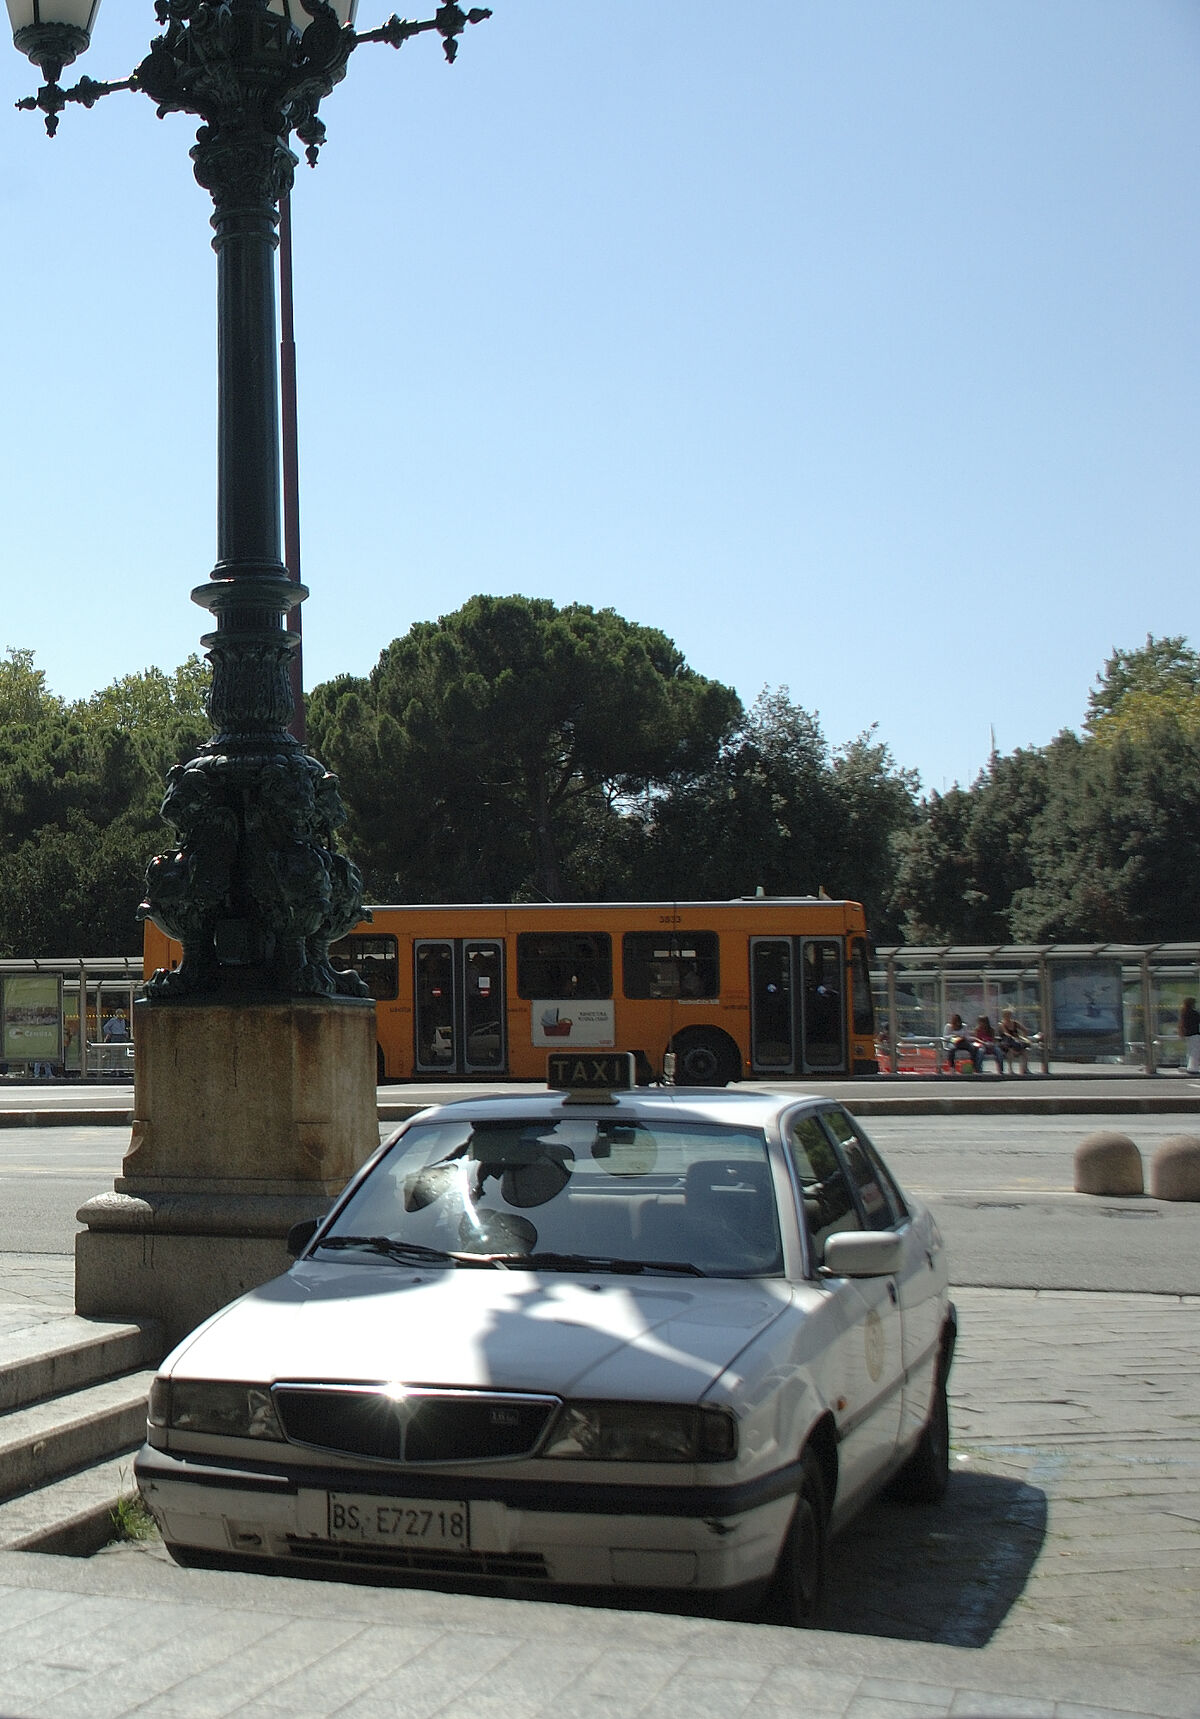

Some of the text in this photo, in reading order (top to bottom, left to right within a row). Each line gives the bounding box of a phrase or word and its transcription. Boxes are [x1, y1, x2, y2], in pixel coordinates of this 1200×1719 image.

[552, 1060, 621, 1082] TAXI
[332, 1503, 464, 1538] BS E72718
